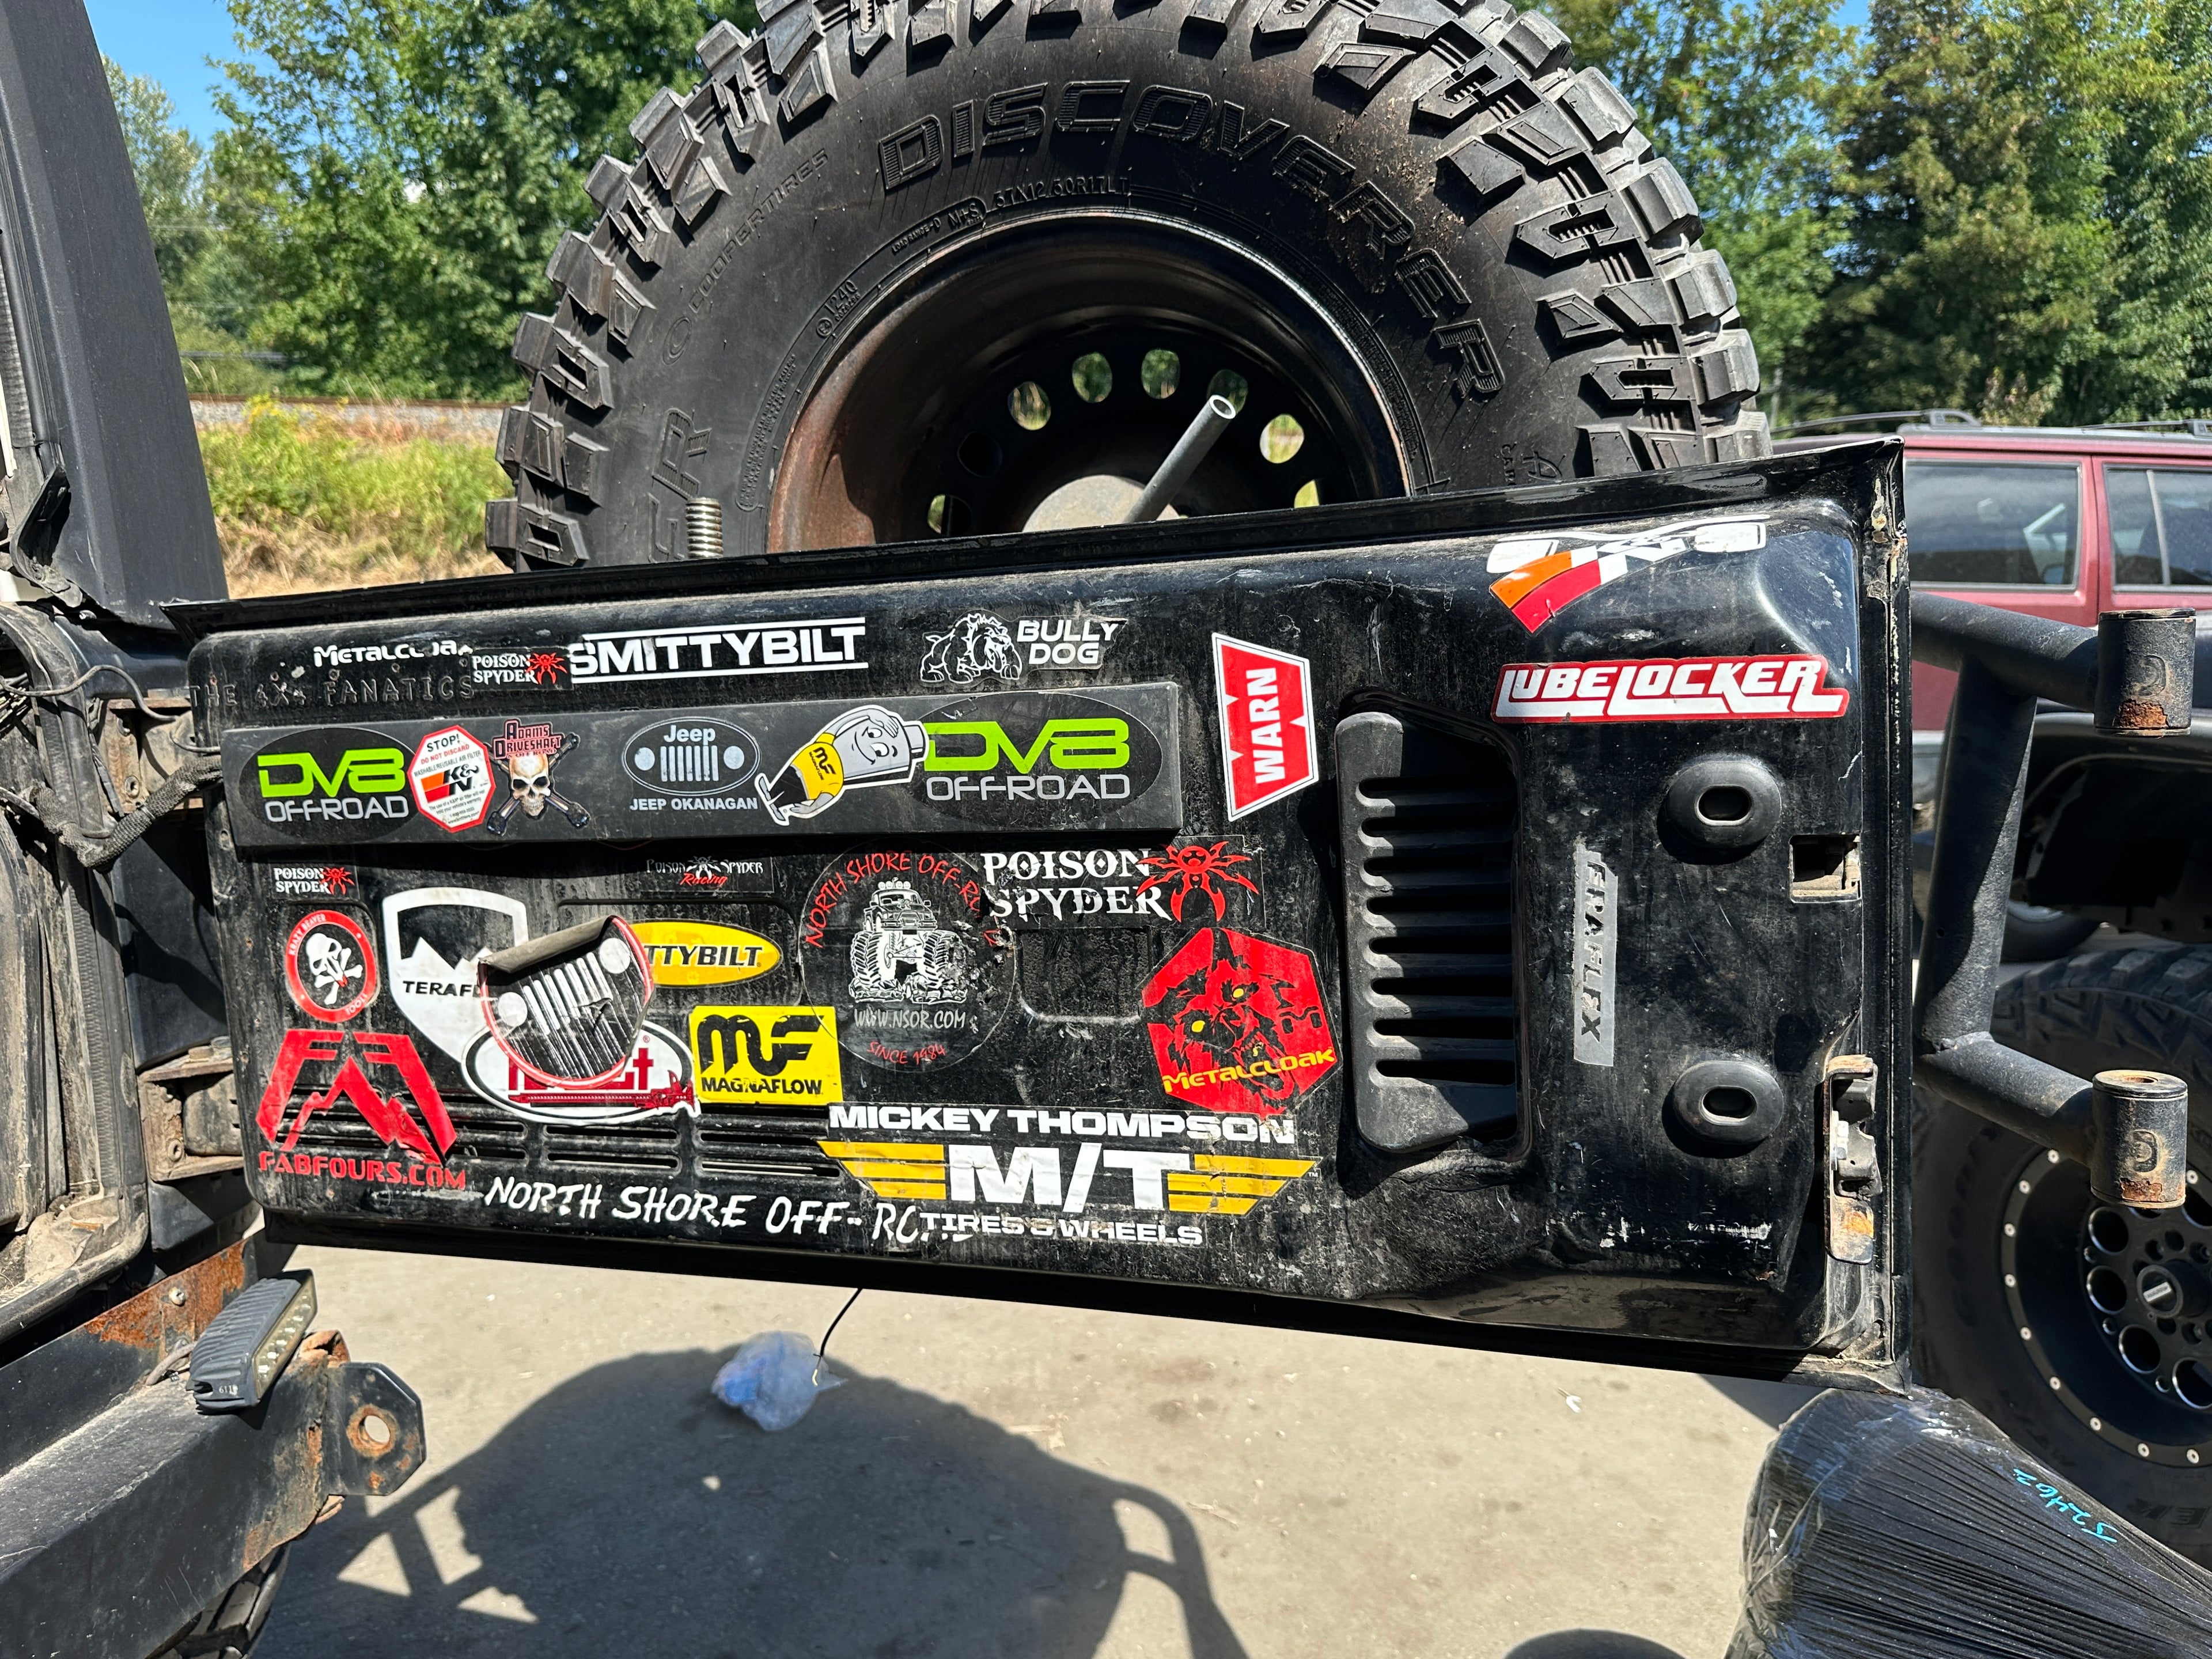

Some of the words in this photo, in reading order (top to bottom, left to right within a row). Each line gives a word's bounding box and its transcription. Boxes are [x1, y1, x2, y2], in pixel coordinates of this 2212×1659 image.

[878, 80, 1505, 400] DISCOVERER
[1017, 620, 1119, 642] BULLY
[472, 653, 536, 670] POISON
[569, 626, 865, 676] SMITTYBILT
[1028, 643, 1100, 665] DOG
[473, 669, 539, 685] SPYDER
[190, 684, 238, 708] THE
[323, 675, 476, 707] FANATICS
[1495, 660, 1844, 717] LUBELOCKER
[506, 722, 550, 740] ADAMS
[663, 725, 716, 747] Jeep
[1245, 668, 1286, 784] WARN
[427, 734, 460, 752] STOP!
[430, 753, 442, 762] NOT
[444, 744, 470, 757] DISCARD
[495, 737, 562, 757] DRIVESHAFT
[924, 718, 1130, 774] DV8
[467, 750, 482, 760] FILTER
[257, 747, 405, 798] DV8
[630, 798, 667, 811] JEEP
[672, 797, 759, 810] OKANAGAN
[274, 867, 325, 881] POISON
[646, 858, 686, 874] POISON
[720, 860, 764, 874] SPYDER
[980, 848, 1152, 885] POISON
[275, 881, 332, 894] SPYDER
[680, 872, 728, 889] Racing
[805, 872, 849, 948] NORTH
[846, 850, 912, 884] SHORE
[982, 885, 1173, 922] SPYDER
[643, 945, 763, 967] TTYBILT
[866, 1041, 908, 1065] SINCE
[701, 1077, 823, 1095] MAGNAFLOW
[828, 1105, 1000, 1132] MICKEY
[1006, 1109, 1296, 1144] THOMPSON
[258, 1150, 467, 1191] FABFOURS.COM
[948, 1142, 1191, 1214] M/T
[484, 1176, 603, 1219] NORTH
[610, 1185, 758, 1229] SHORE
[1058, 1219, 1203, 1245] WHEELS
